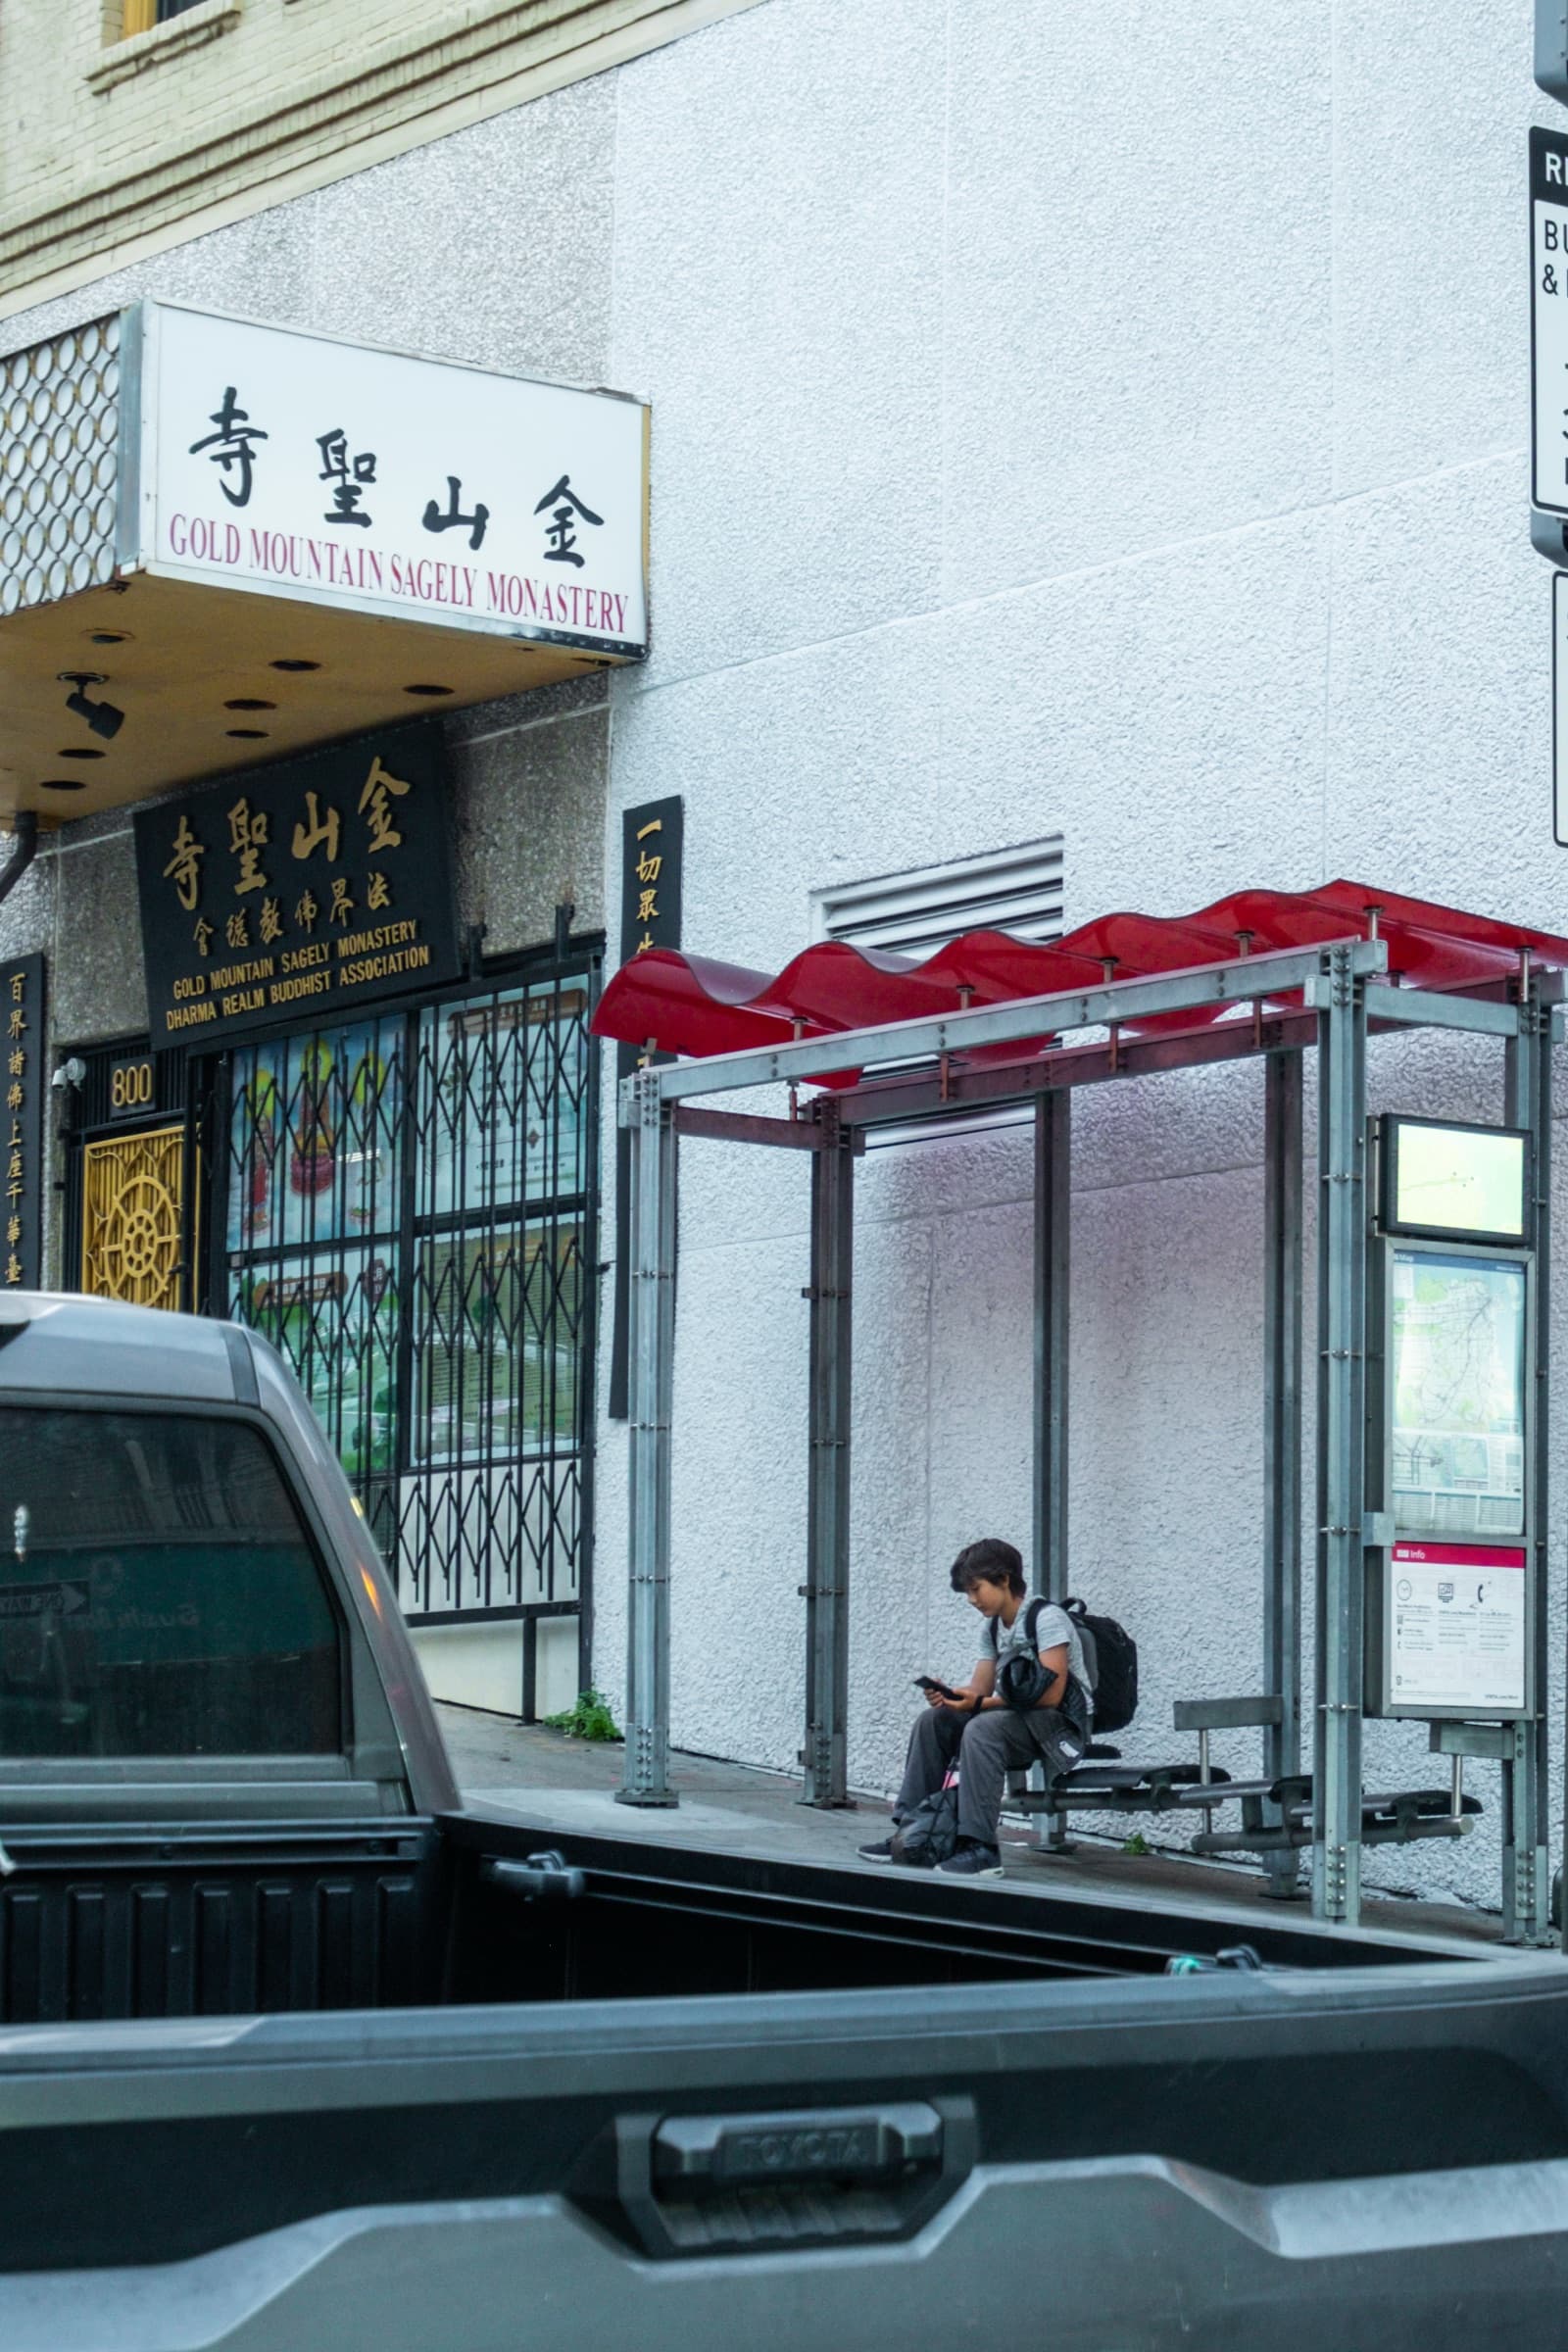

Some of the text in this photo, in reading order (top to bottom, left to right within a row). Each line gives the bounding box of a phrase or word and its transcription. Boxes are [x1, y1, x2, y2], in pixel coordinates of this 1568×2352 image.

[1543, 263, 1558, 296] &
[170, 513, 629, 634] GOLD MOUNTAIN SAGELY MONASTERY
[166, 945, 429, 1031] DHARMA REALM BUDDHIST ASSOCIATION
[173, 919, 416, 1001] GOLD MOUNTAIN SAGELY MONASTERY
[112, 1063, 152, 1108] 800
